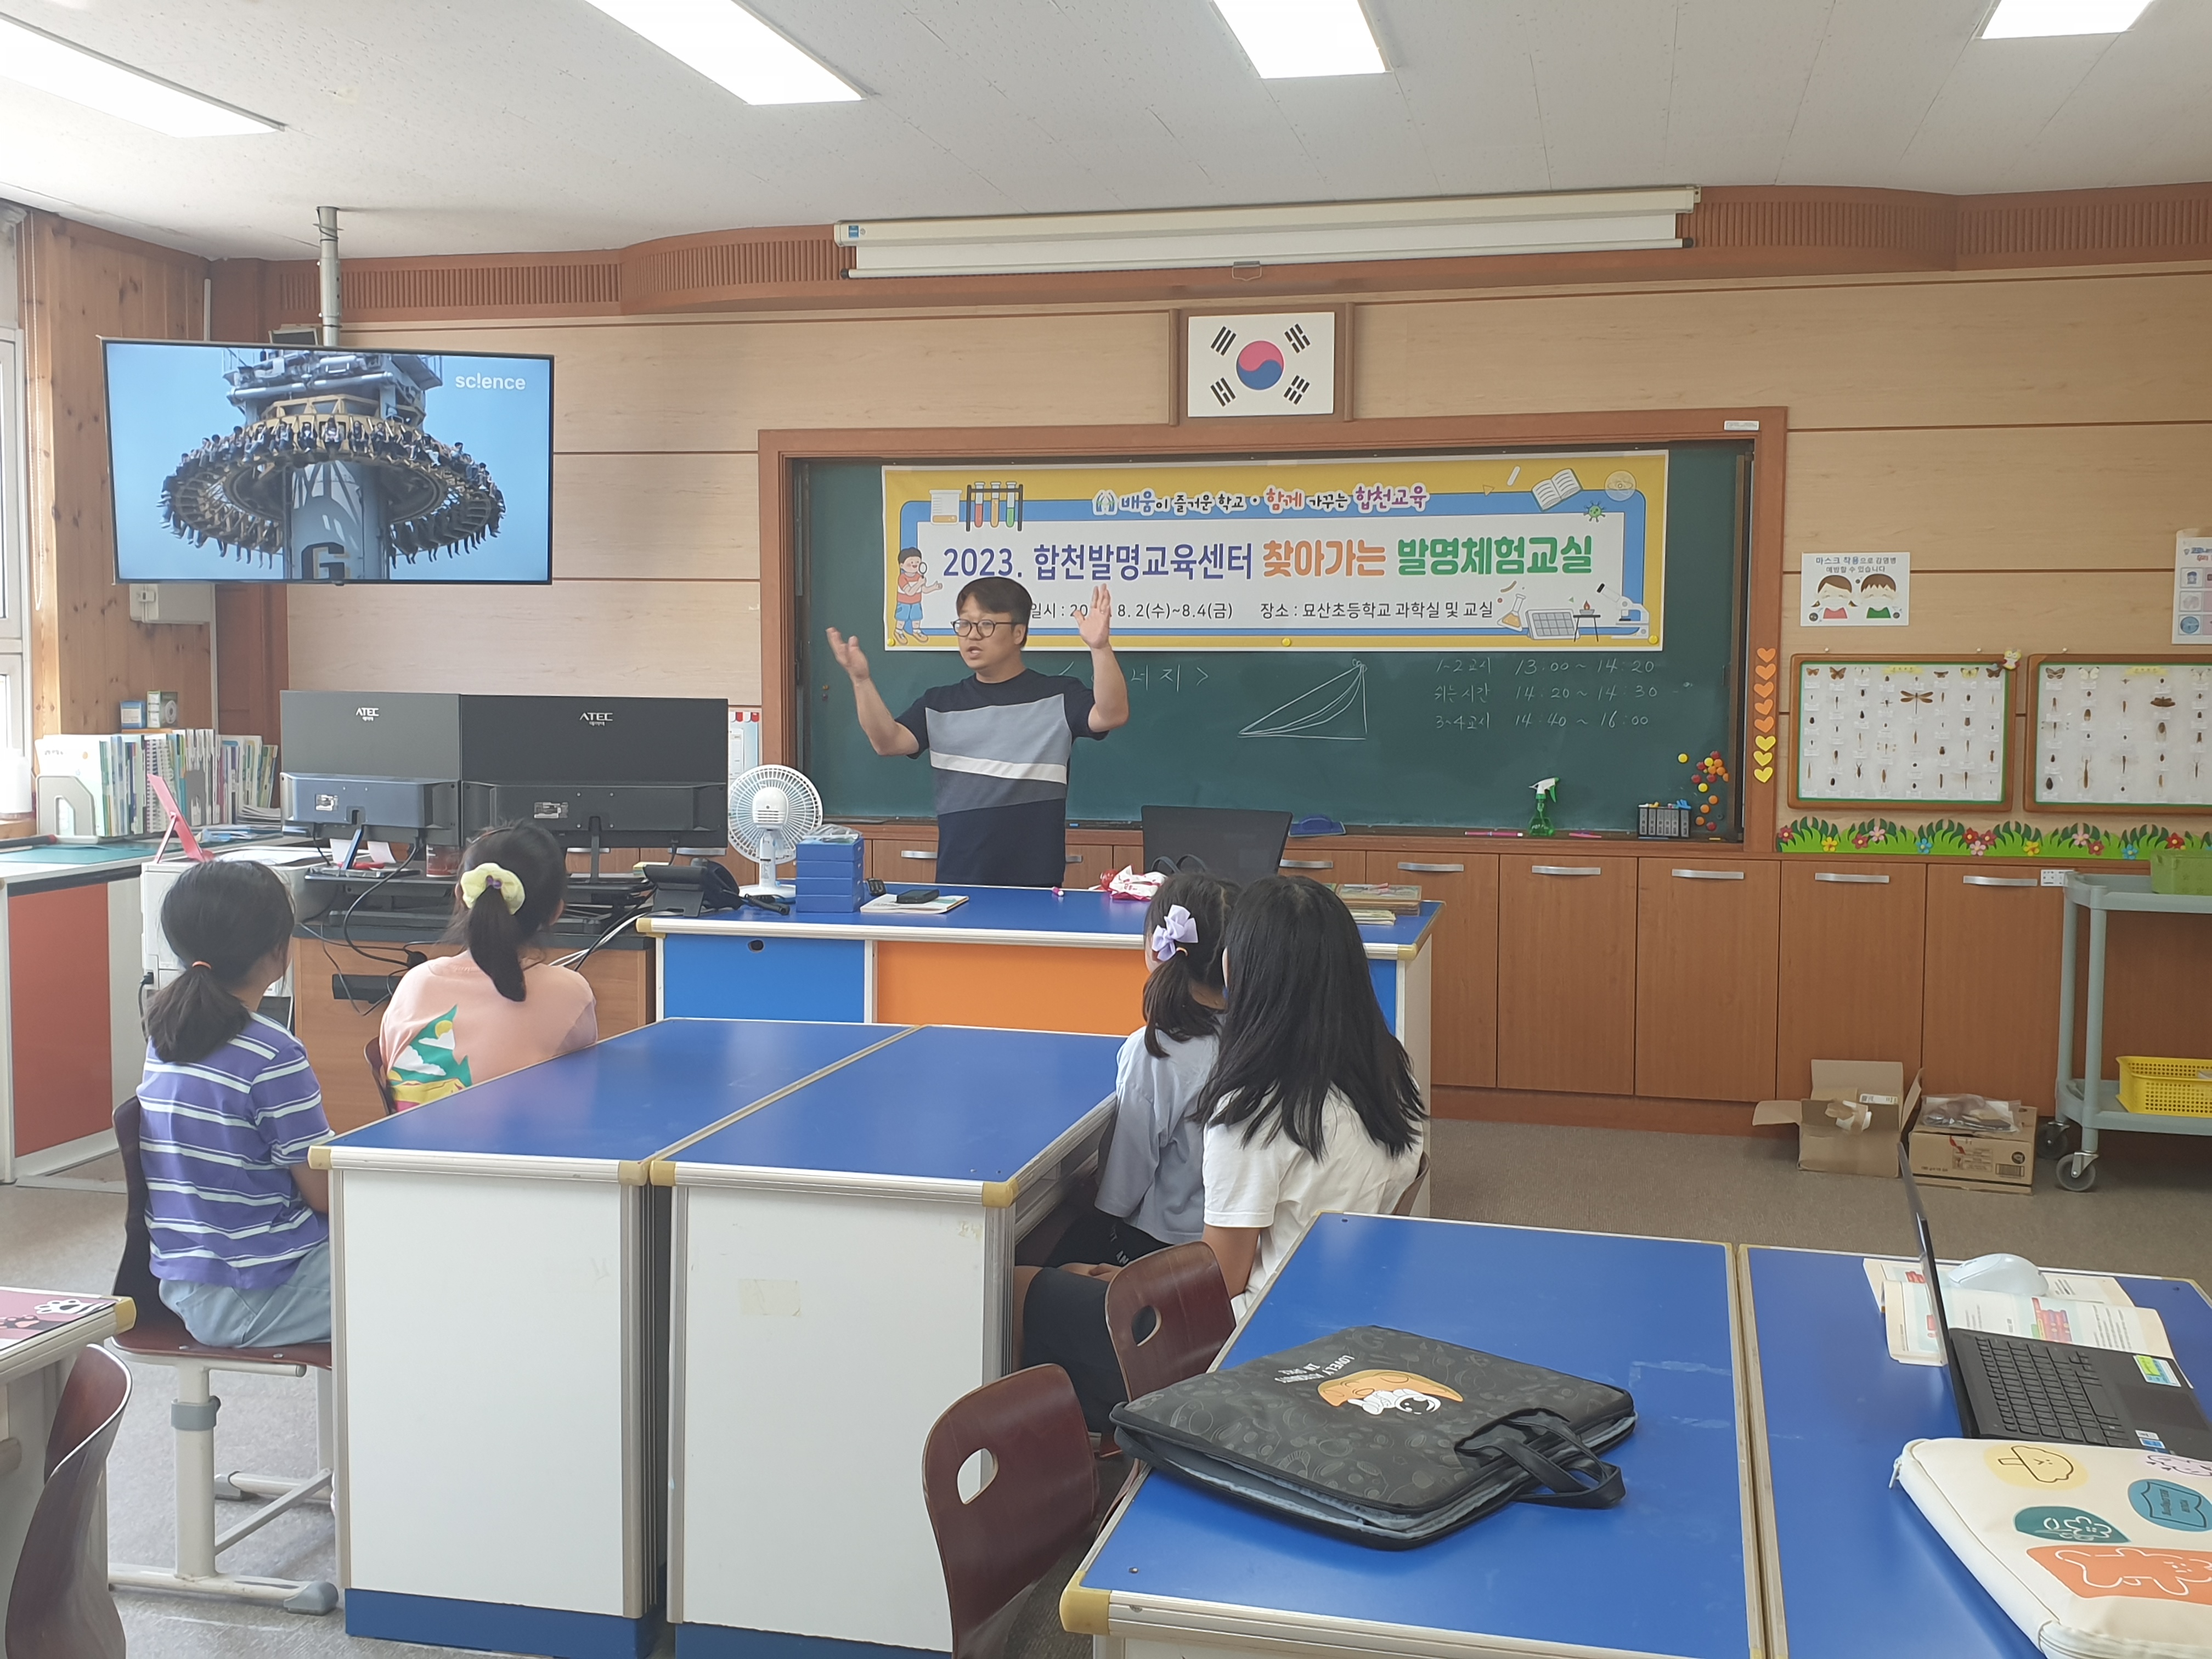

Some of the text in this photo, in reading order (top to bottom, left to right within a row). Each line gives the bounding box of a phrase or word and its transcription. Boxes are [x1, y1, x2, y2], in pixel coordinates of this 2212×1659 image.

[1121, 491, 1167, 512] 배움이
[1175, 494, 1212, 512] 즐거운
[1218, 494, 1244, 510] 학교
[1266, 488, 1302, 510] 함께
[1310, 493, 1347, 509] 가꾸는
[1356, 486, 1426, 510] 합천교육
[943, 535, 1592, 581] 2023. 합천발명교육센터 찾아가는 발명체험교실
[1843, 556, 1874, 565] 착용으로
[1261, 603, 1289, 619] 장소
[1302, 602, 1391, 619] 묘산초등학교
[1396, 601, 1440, 618] 과학실
[1446, 601, 1458, 618] 및
[1463, 601, 1493, 618] 교실
[356, 707, 379, 716] ATEC
[579, 713, 613, 721] ATEC
[1322, 1355, 1355, 1375] LOVELY
